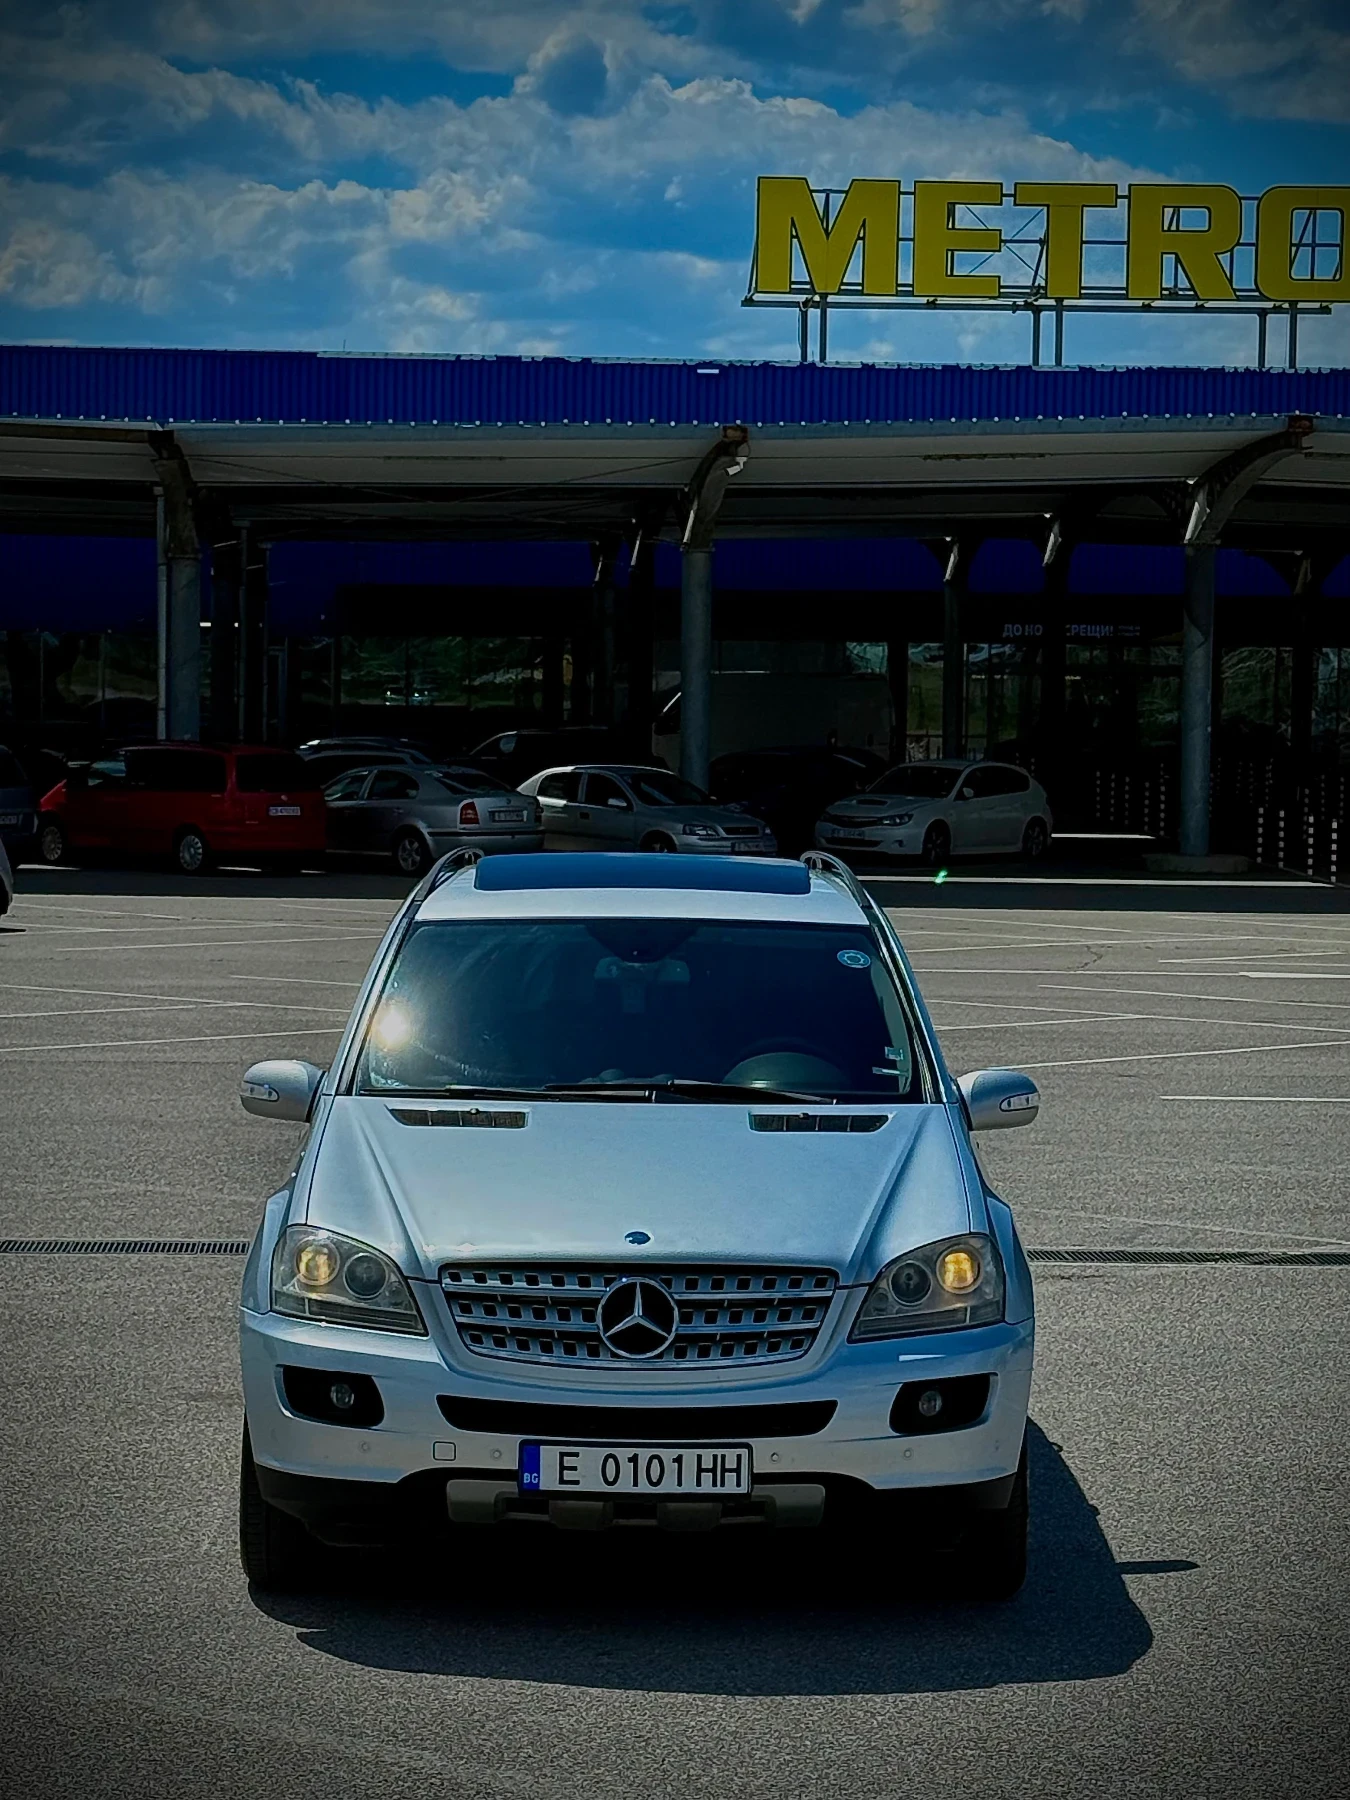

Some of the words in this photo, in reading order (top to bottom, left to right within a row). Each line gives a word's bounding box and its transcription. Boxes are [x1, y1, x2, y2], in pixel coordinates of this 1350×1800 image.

[757, 176, 1350, 301] METRO
[523, 1473, 539, 1484] BG
[558, 1451, 580, 1486] E
